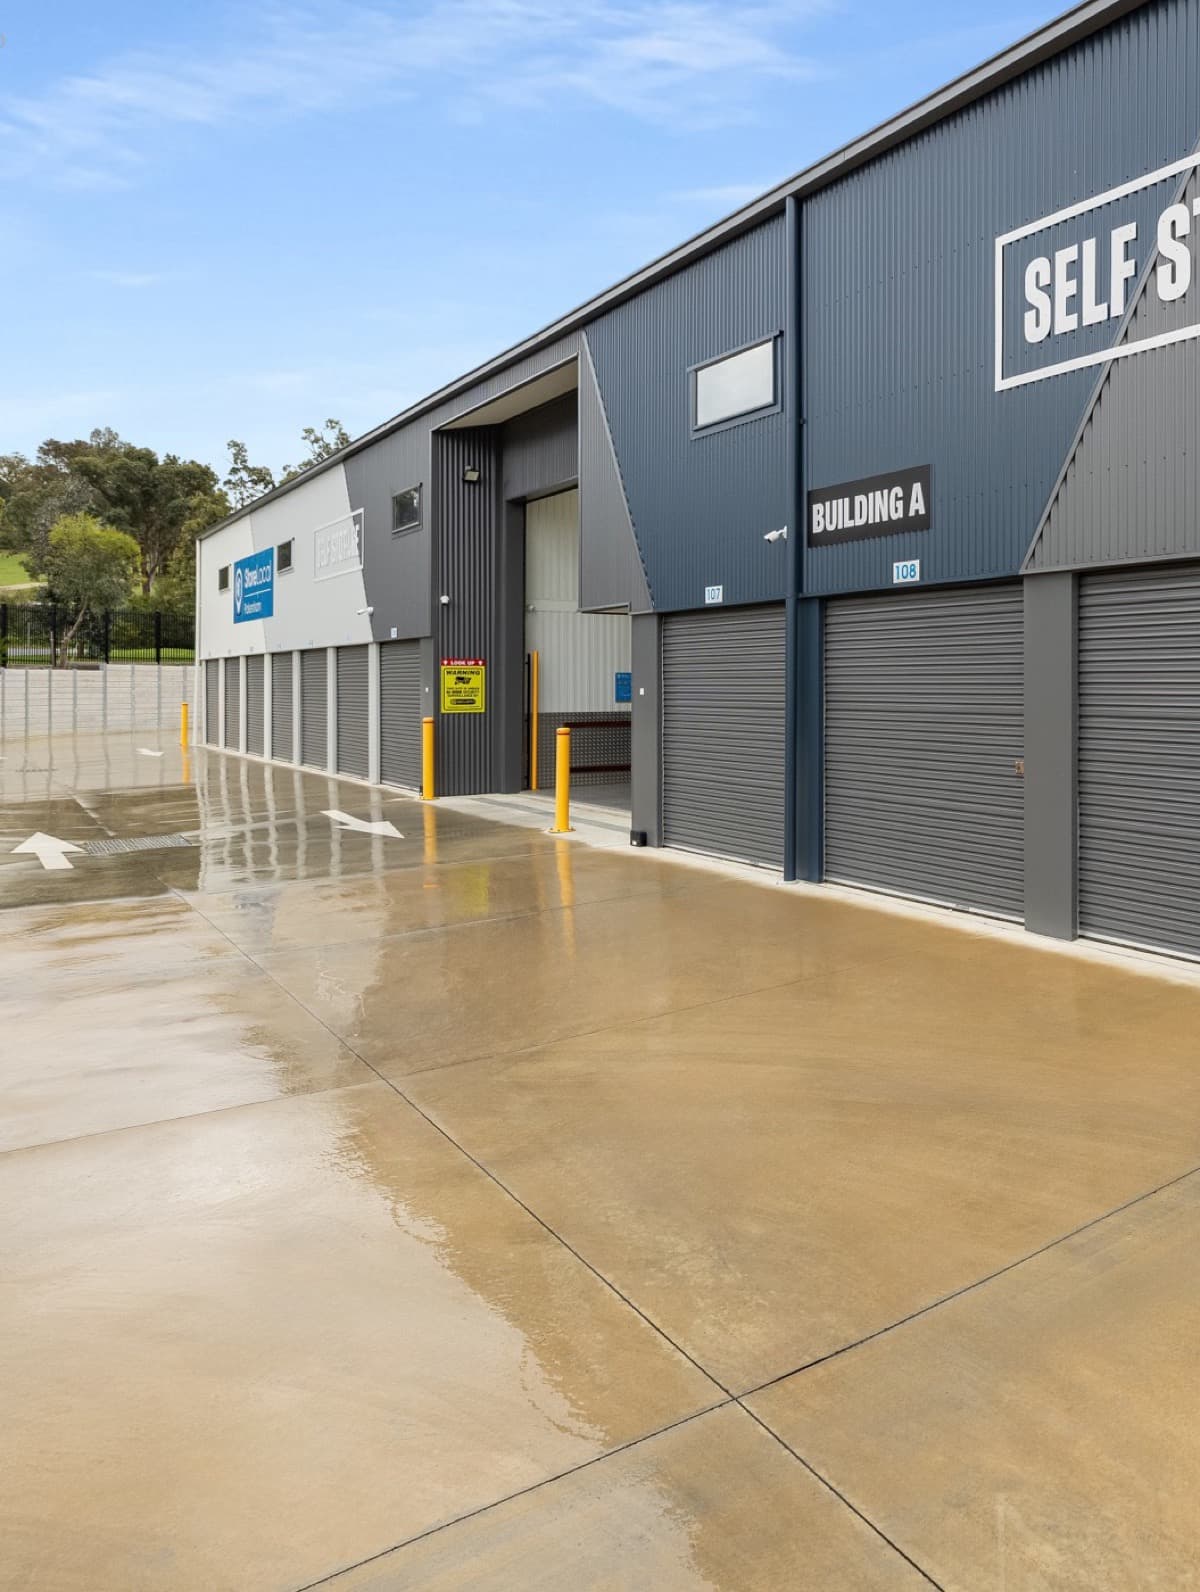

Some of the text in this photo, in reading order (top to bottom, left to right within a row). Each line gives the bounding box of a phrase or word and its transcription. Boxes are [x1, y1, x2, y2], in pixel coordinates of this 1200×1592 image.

[1023, 221, 1137, 344] SELF
[812, 481, 926, 534] BUILDING A
[895, 563, 917, 580] 108
[707, 587, 721, 601] 107
